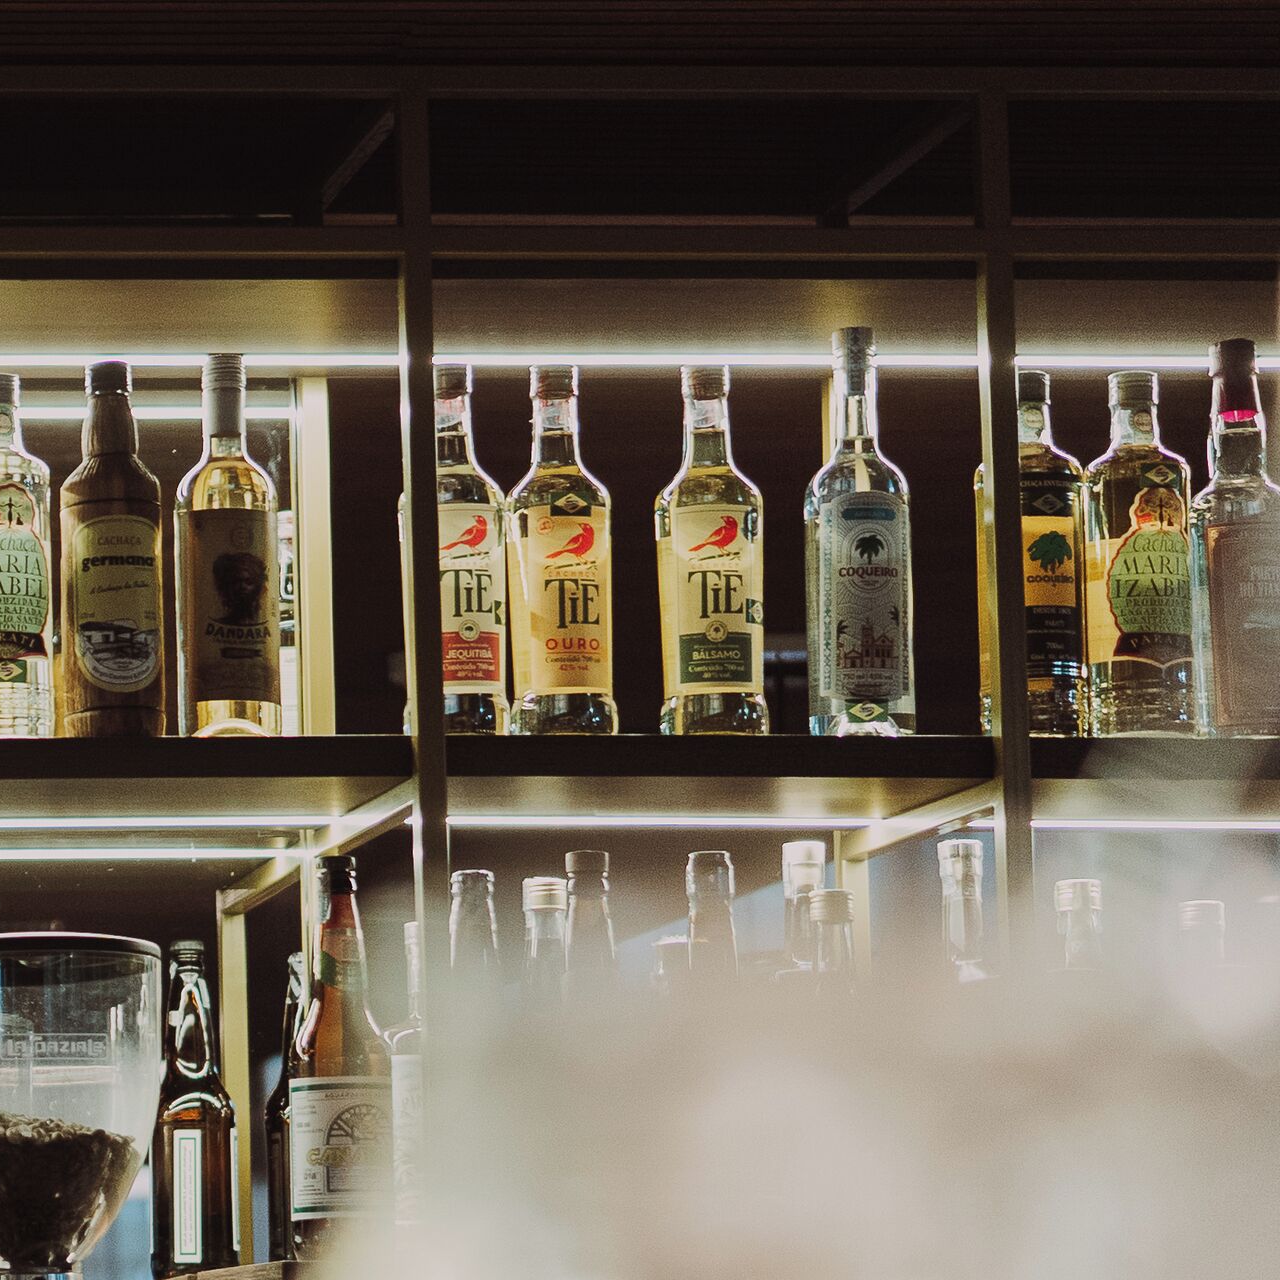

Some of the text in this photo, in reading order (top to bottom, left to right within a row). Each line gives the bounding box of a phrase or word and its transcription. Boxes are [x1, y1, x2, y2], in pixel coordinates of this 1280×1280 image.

[81, 555, 155, 573] germana
[838, 566, 899, 579] COQUEIRO
[205, 623, 271, 640] DANDARA
[546, 638, 600, 651] OURO
[445, 647, 494, 659] JEQUITIBÁ
[692, 648, 741, 660] BÁLSAMO
